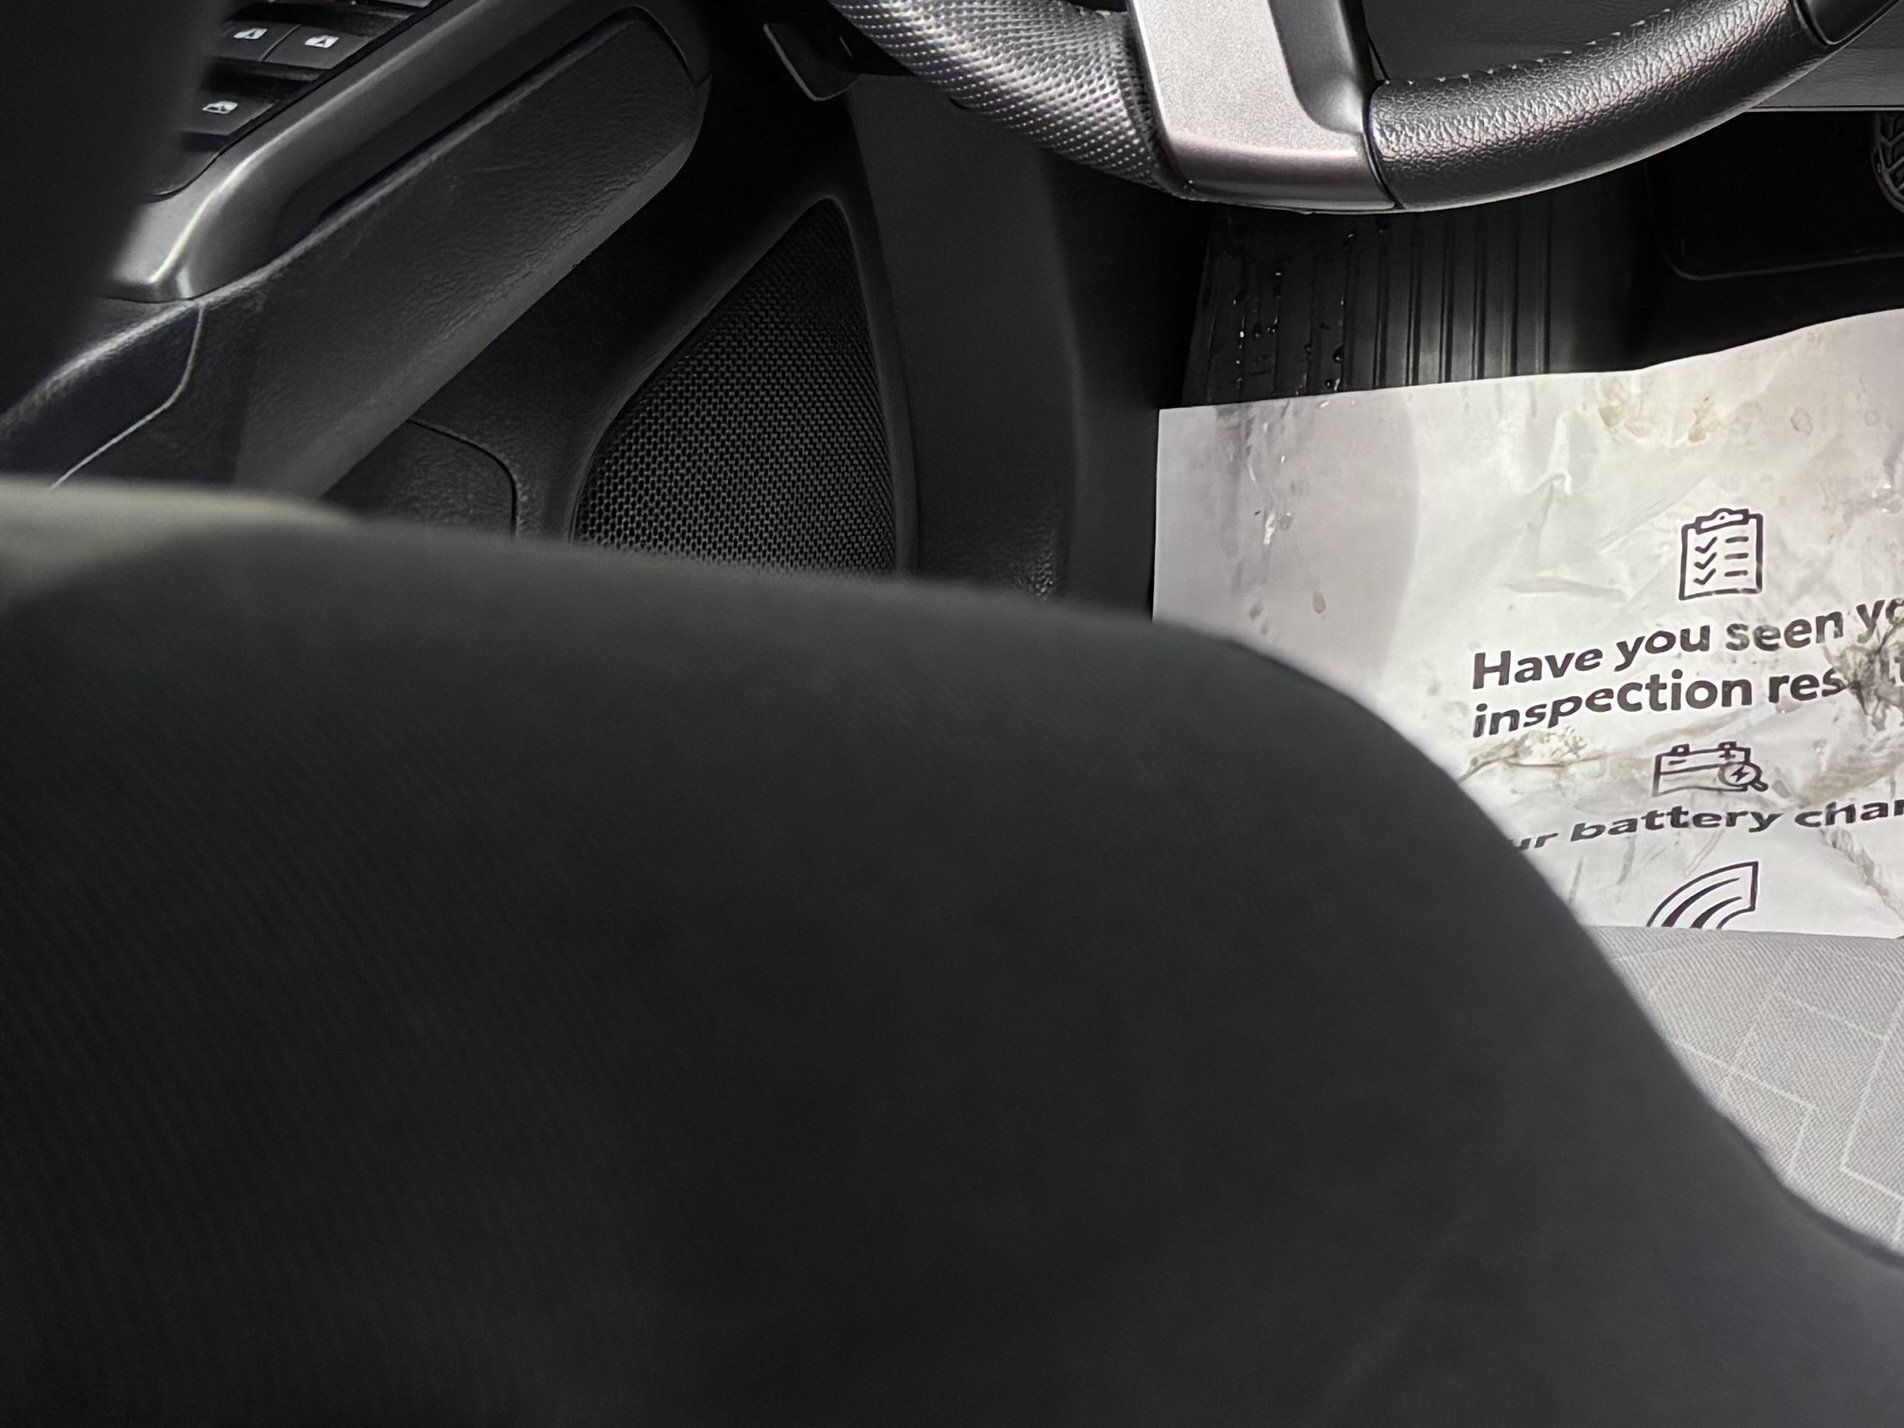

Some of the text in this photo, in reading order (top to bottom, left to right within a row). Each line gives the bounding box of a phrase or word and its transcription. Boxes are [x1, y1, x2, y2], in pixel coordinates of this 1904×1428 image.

[1471, 643, 1606, 690] Have
[1614, 623, 1712, 675] you
[1726, 607, 1844, 654] seen
[1471, 668, 1754, 739] inspection
[1570, 801, 1794, 844] battery
